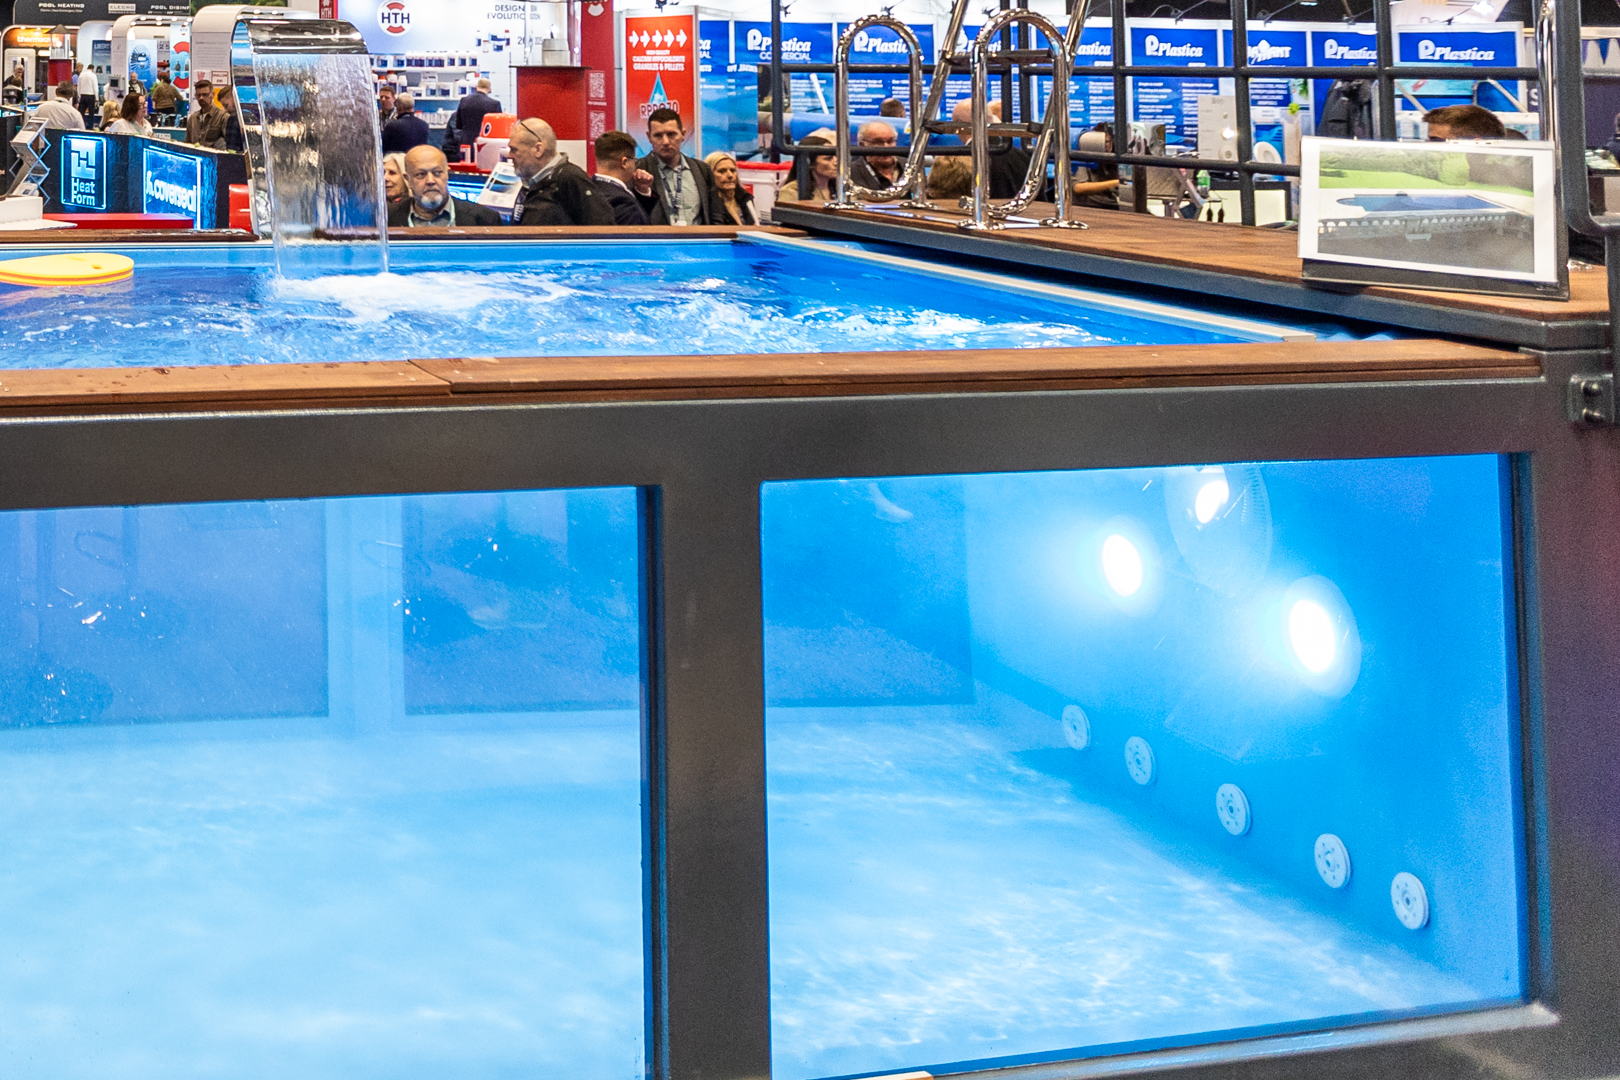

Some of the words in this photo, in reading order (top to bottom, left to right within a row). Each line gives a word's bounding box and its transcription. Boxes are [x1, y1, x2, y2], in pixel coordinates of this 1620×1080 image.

[494, 4, 525, 12] DESIGN
[381, 12, 410, 24] HTH
[761, 35, 812, 52] Pstica
[868, 38, 909, 53] Plastic
[1078, 40, 1111, 56] astica
[1158, 42, 1203, 57] Plastica
[1433, 46, 1495, 61] Plastica
[71, 177, 96, 194] Heat
[71, 191, 96, 207] Form
